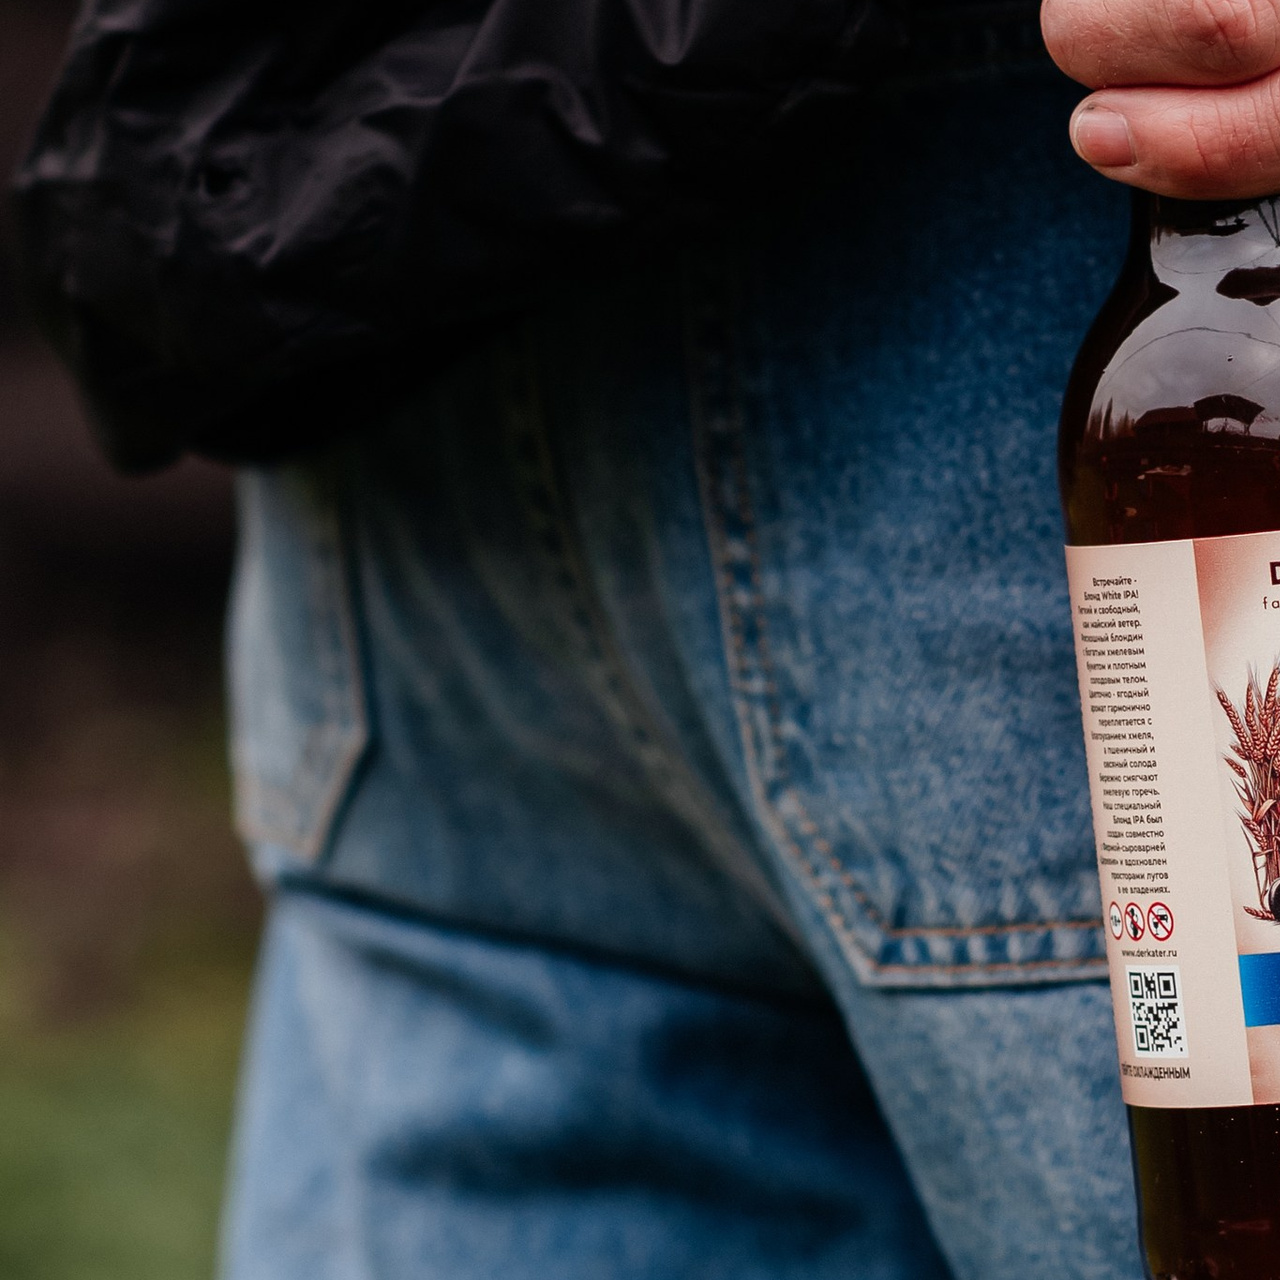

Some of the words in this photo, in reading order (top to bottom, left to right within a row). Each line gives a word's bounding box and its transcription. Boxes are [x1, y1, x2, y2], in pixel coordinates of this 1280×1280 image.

[1092, 575, 1132, 588] Встречайте
[1101, 590, 1122, 600] White
[1123, 589, 1139, 599] IPA!
[1098, 603, 1141, 615] свободный,
[1118, 619, 1142, 629] ветер.
[1110, 632, 1144, 643] блондин
[1107, 647, 1145, 656] хмелевым
[1112, 661, 1147, 670] плотным
[1122, 675, 1148, 684] телом.
[1116, 687, 1149, 699] ягодный
[1107, 703, 1151, 714] гармонично
[1098, 718, 1146, 728] переплетается
[1128, 732, 1155, 741] хмеля,
[1107, 743, 1148, 755] пшеничный
[1149, 745, 1156, 753] и
[1129, 759, 1157, 769] солода
[1122, 774, 1158, 783] смягчают
[1131, 788, 1160, 798] горечь.
[1114, 799, 1162, 811] специальный
[1113, 814, 1132, 825] Блонд
[1132, 814, 1145, 824] IPA
[1146, 813, 1163, 824] был
[1125, 829, 1165, 838] совместно
[1125, 858, 1168, 866] вдохновлен
[1146, 872, 1169, 882] лугов
[1121, 948, 1178, 958] www.derkater.ru
